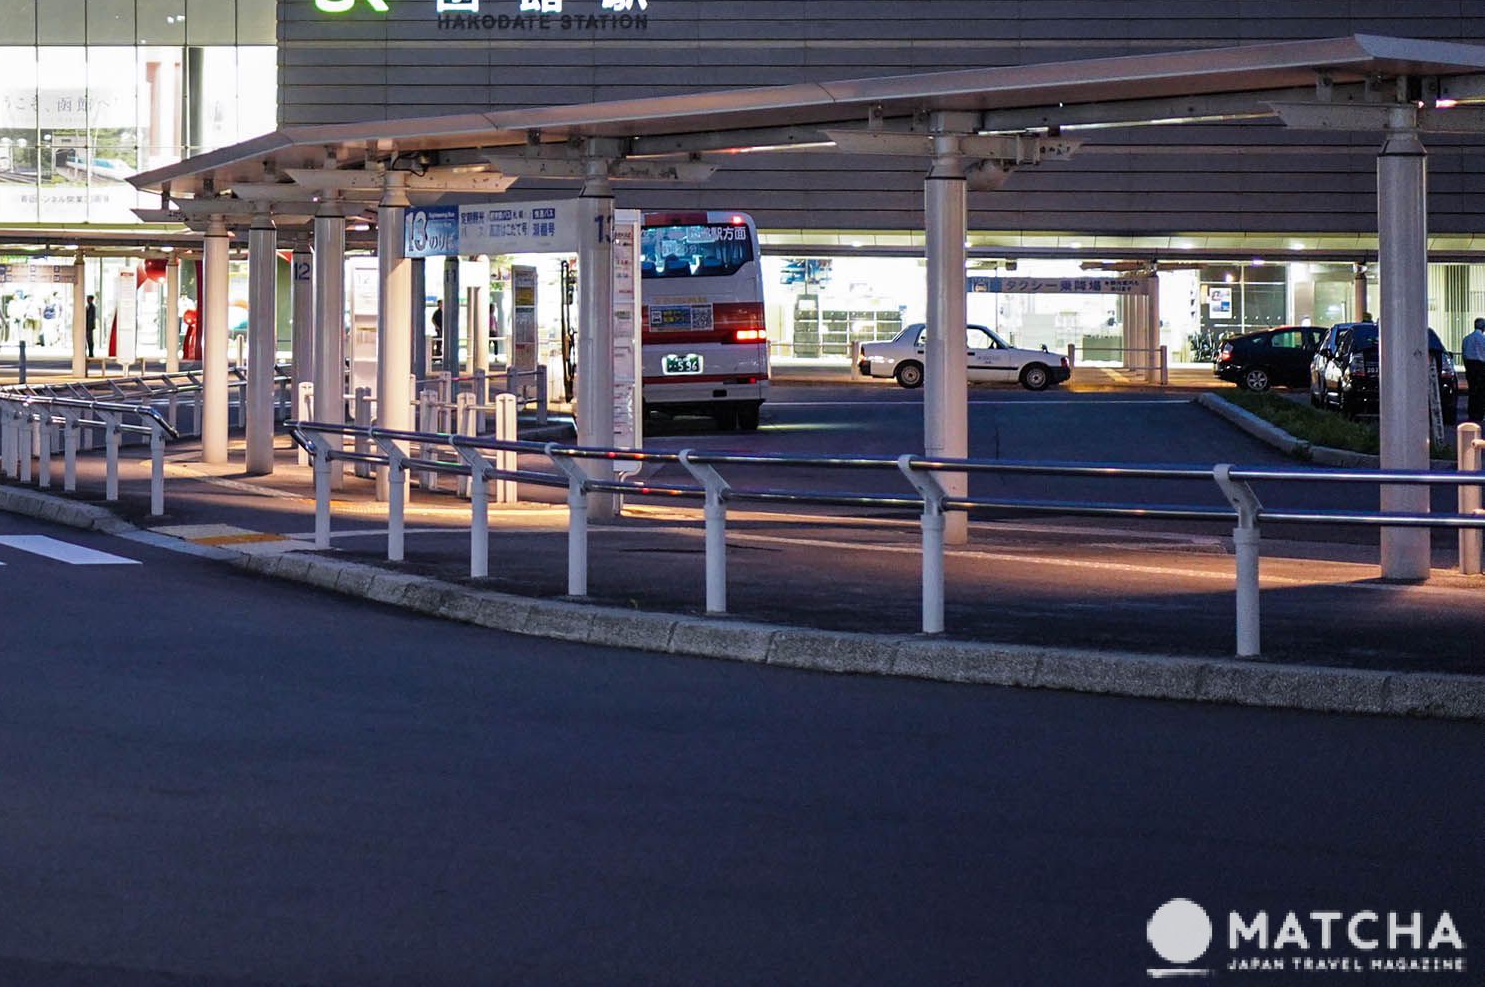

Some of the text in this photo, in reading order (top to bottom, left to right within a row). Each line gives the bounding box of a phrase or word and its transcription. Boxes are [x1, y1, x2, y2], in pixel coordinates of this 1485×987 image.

[437, 14, 648, 31] HAKODATE STATION
[405, 211, 429, 252] 13
[294, 262, 311, 280] 12
[1006, 279, 1102, 292] タクシー乗降場
